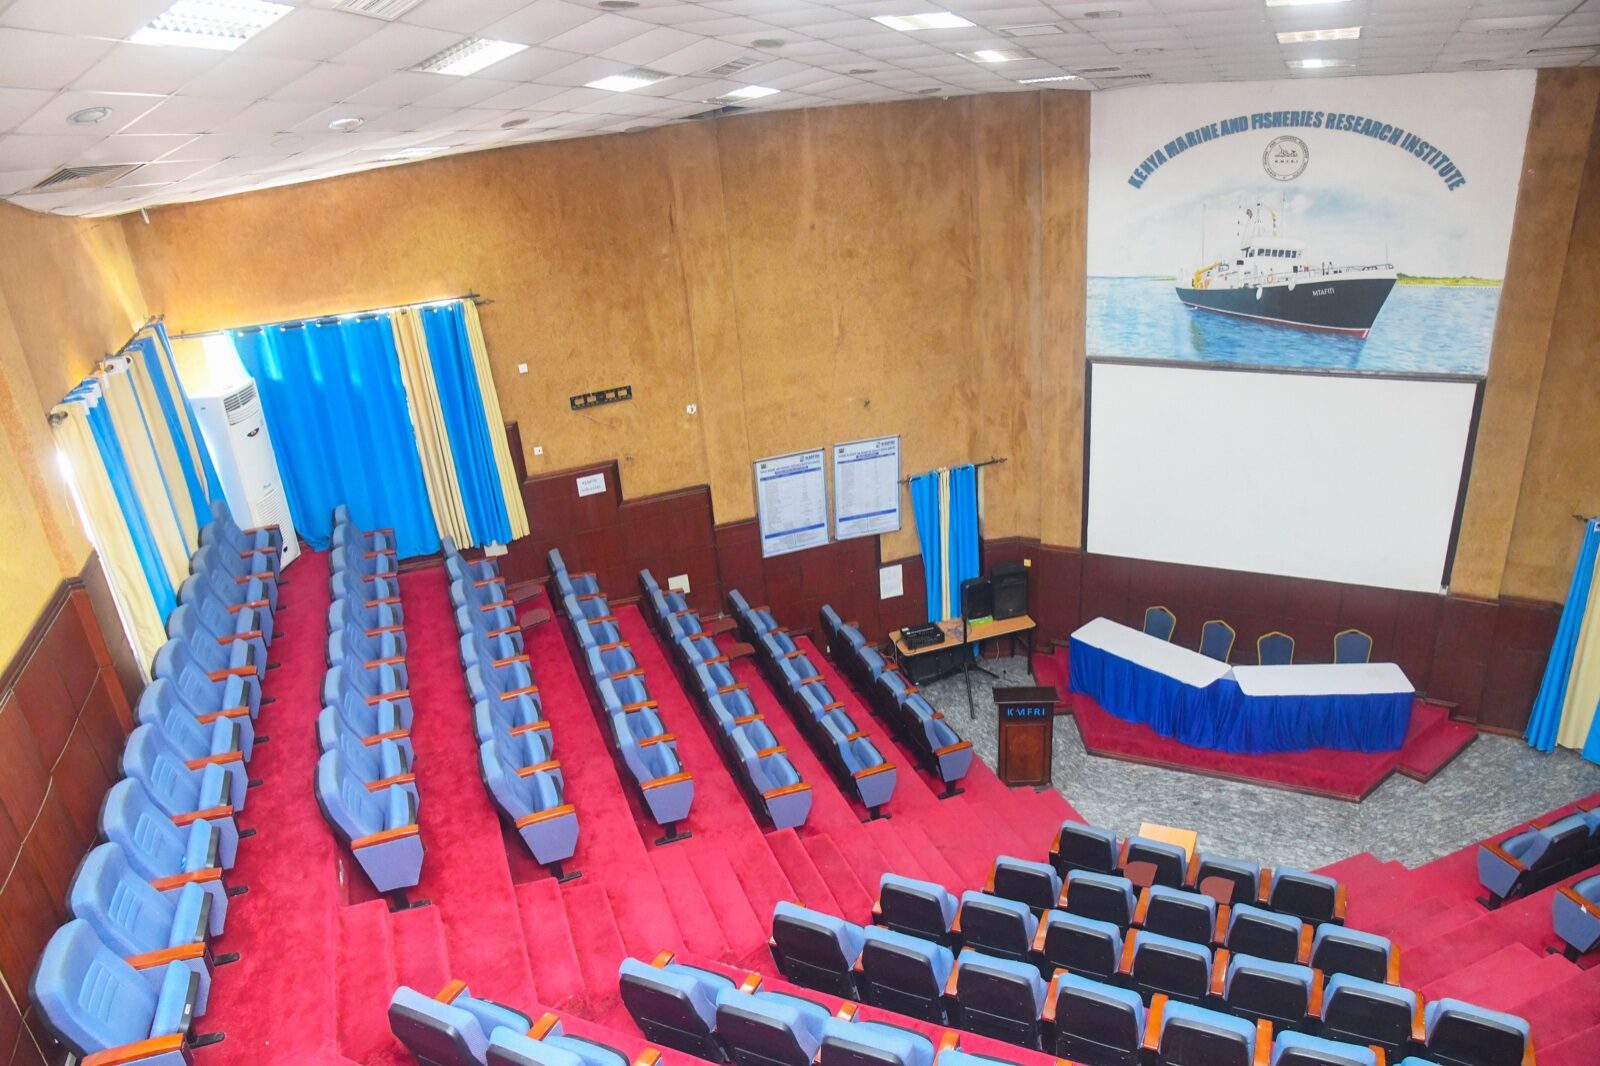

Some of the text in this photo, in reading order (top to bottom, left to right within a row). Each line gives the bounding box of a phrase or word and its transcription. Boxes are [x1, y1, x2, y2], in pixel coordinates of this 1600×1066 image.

[1127, 110, 1466, 191] KENYA MARINE AND FISHERIES RESEARCH INSTITUTE
[1007, 707, 1046, 717] KMFRI
